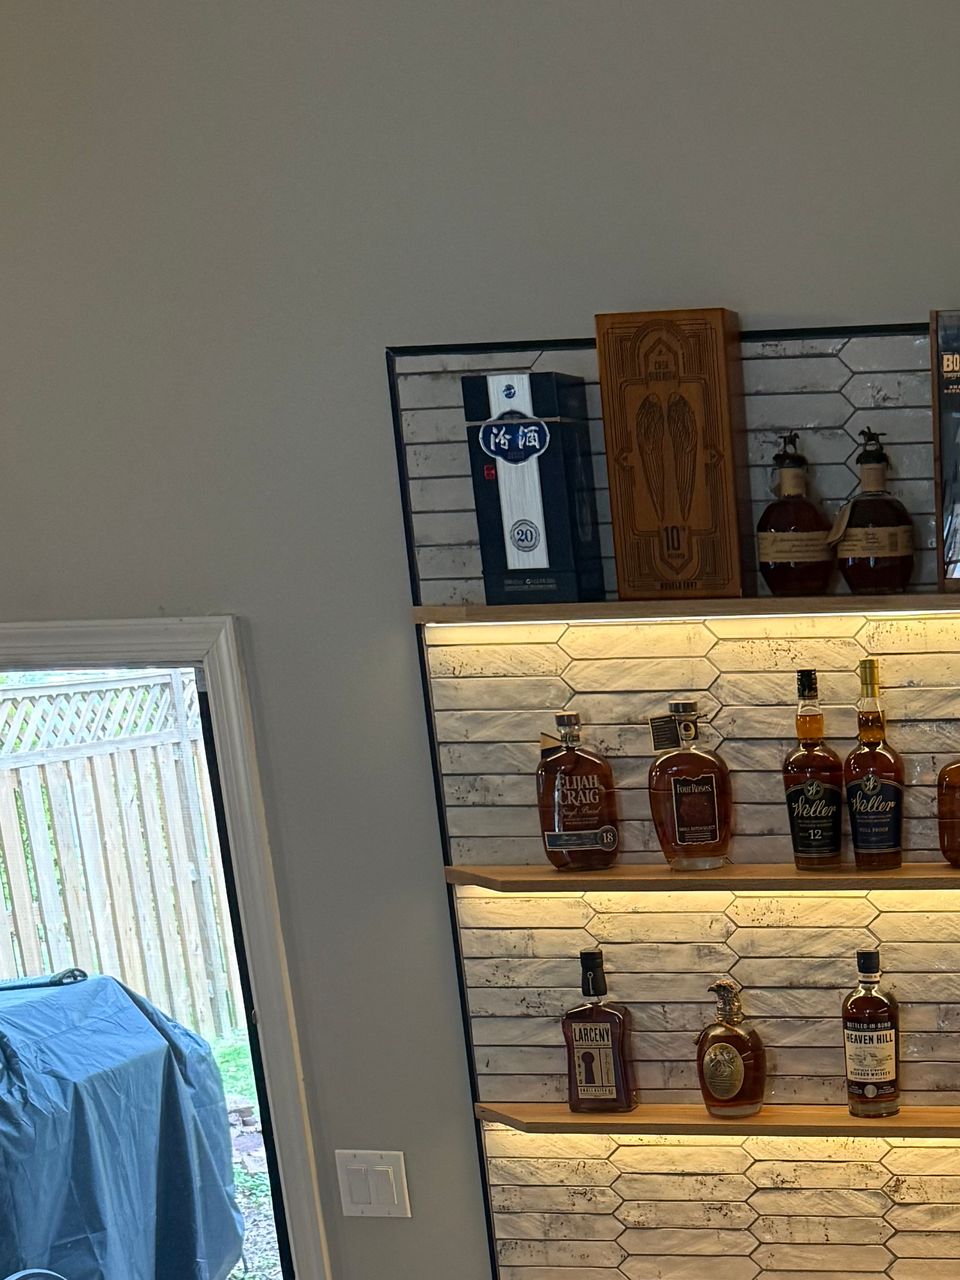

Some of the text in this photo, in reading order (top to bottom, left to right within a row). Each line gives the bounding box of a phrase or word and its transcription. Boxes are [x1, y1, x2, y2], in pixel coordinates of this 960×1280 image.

[489, 425, 540, 452] 汾酒
[516, 528, 533, 543] 20
[560, 788, 600, 806] CRAIG
[850, 790, 896, 812] Weller
[792, 795, 836, 817] Weller
[602, 832, 614, 843] 18
[808, 829, 822, 839] 12
[573, 1027, 610, 1042] LARCENY
[846, 1032, 894, 1045] HEAVEN HILL
